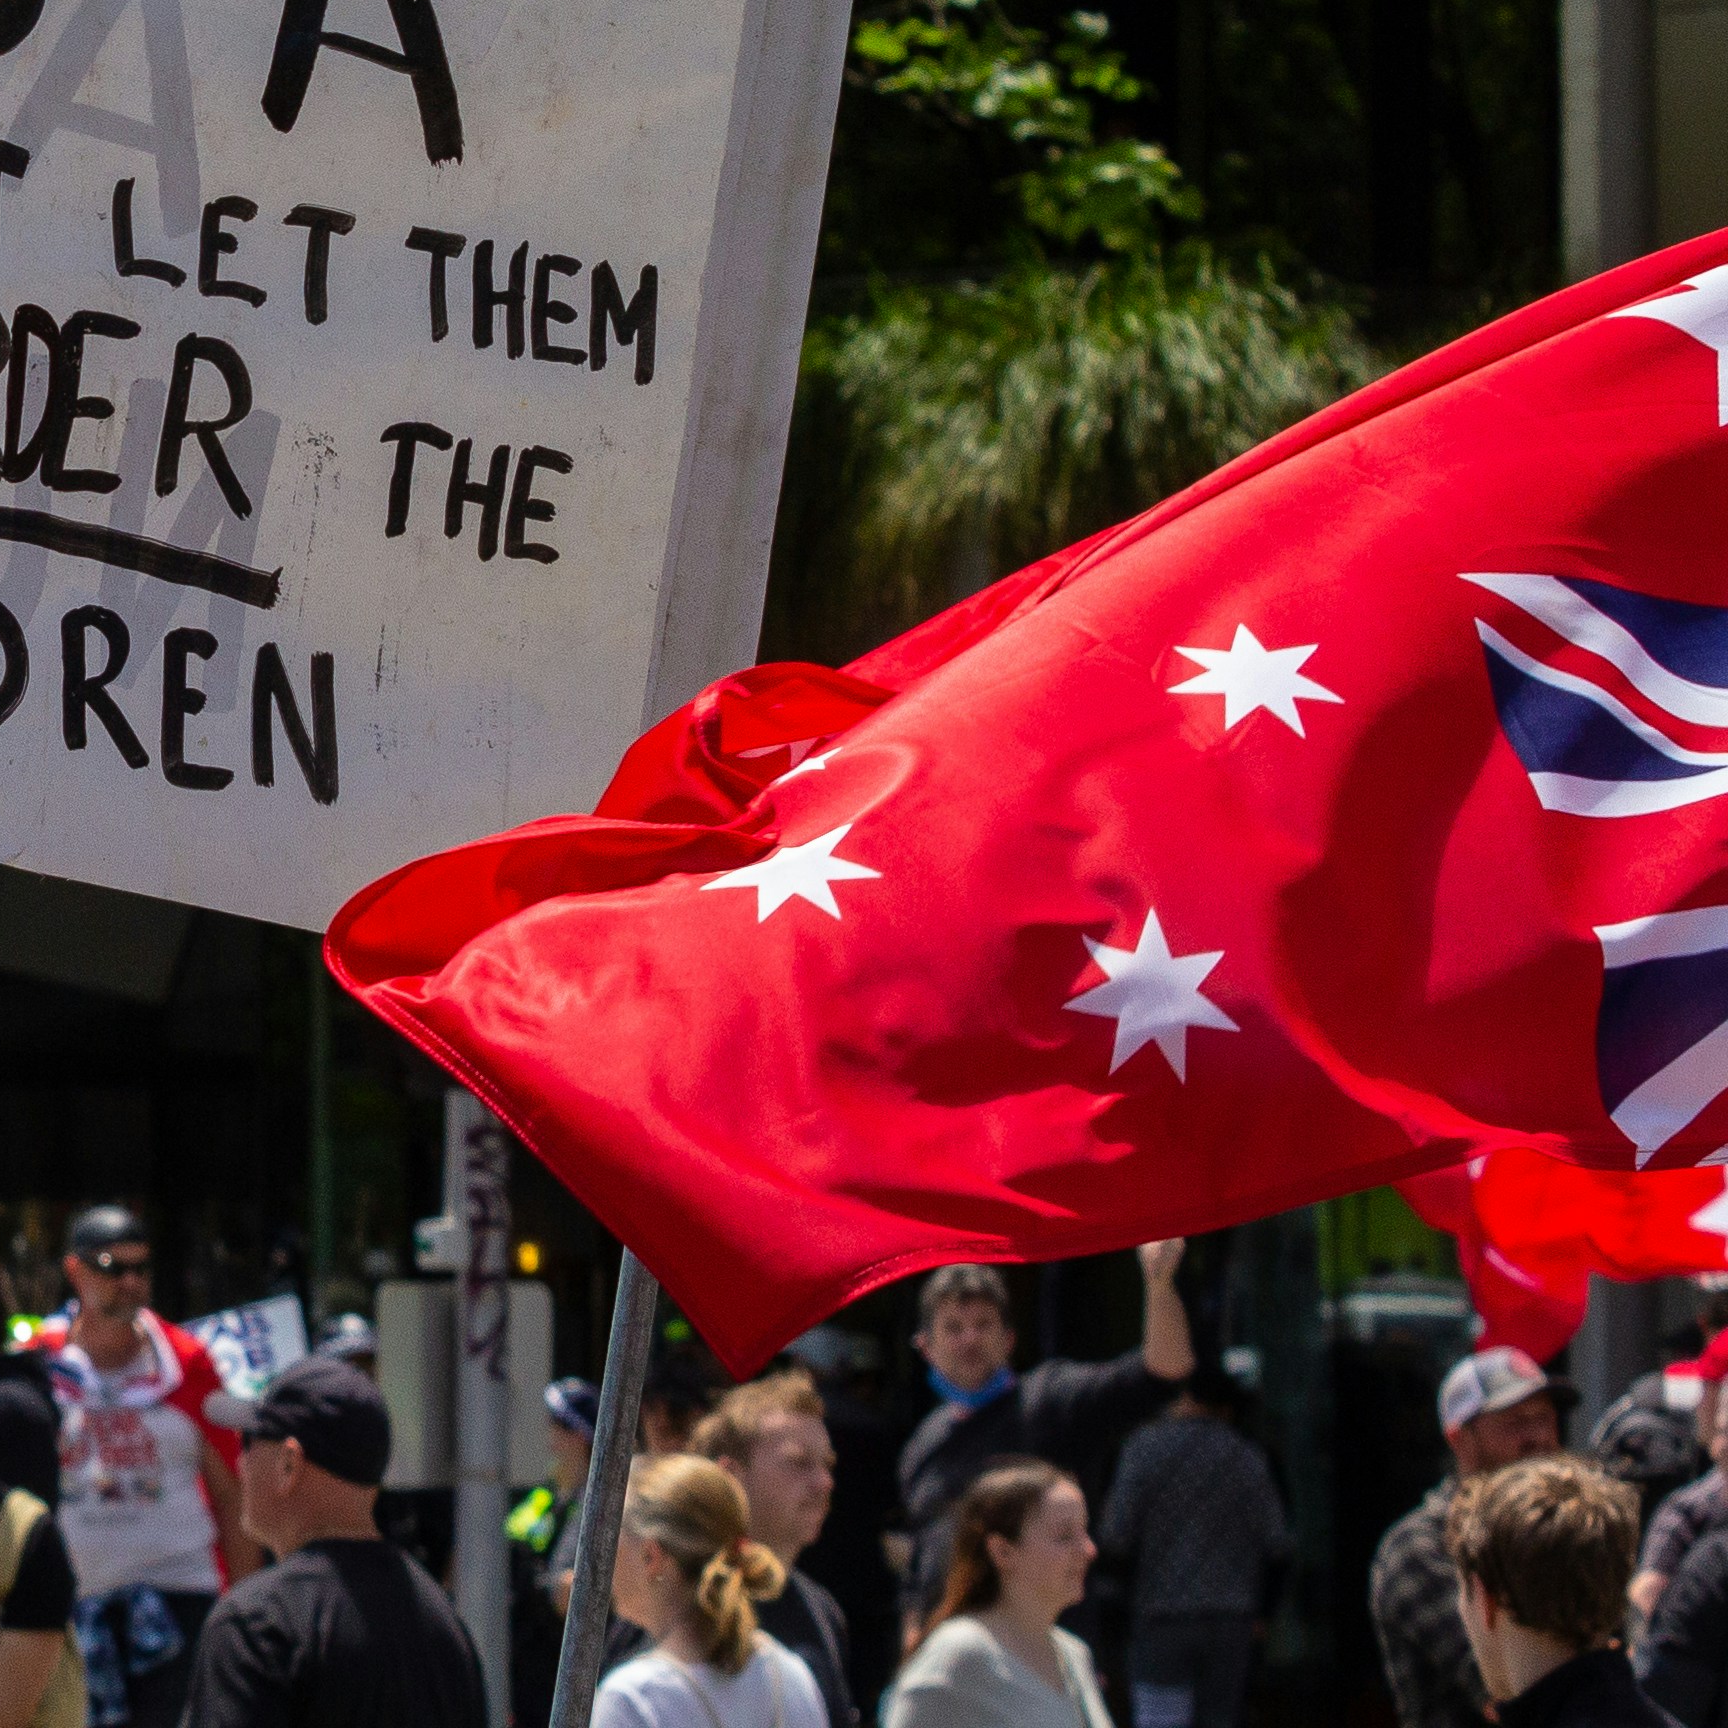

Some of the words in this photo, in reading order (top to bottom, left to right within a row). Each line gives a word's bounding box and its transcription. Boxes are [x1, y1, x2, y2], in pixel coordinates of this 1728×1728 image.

[111, 177, 356, 327] LET
[404, 225, 659, 386] THEM
[379, 421, 574, 565] THE
